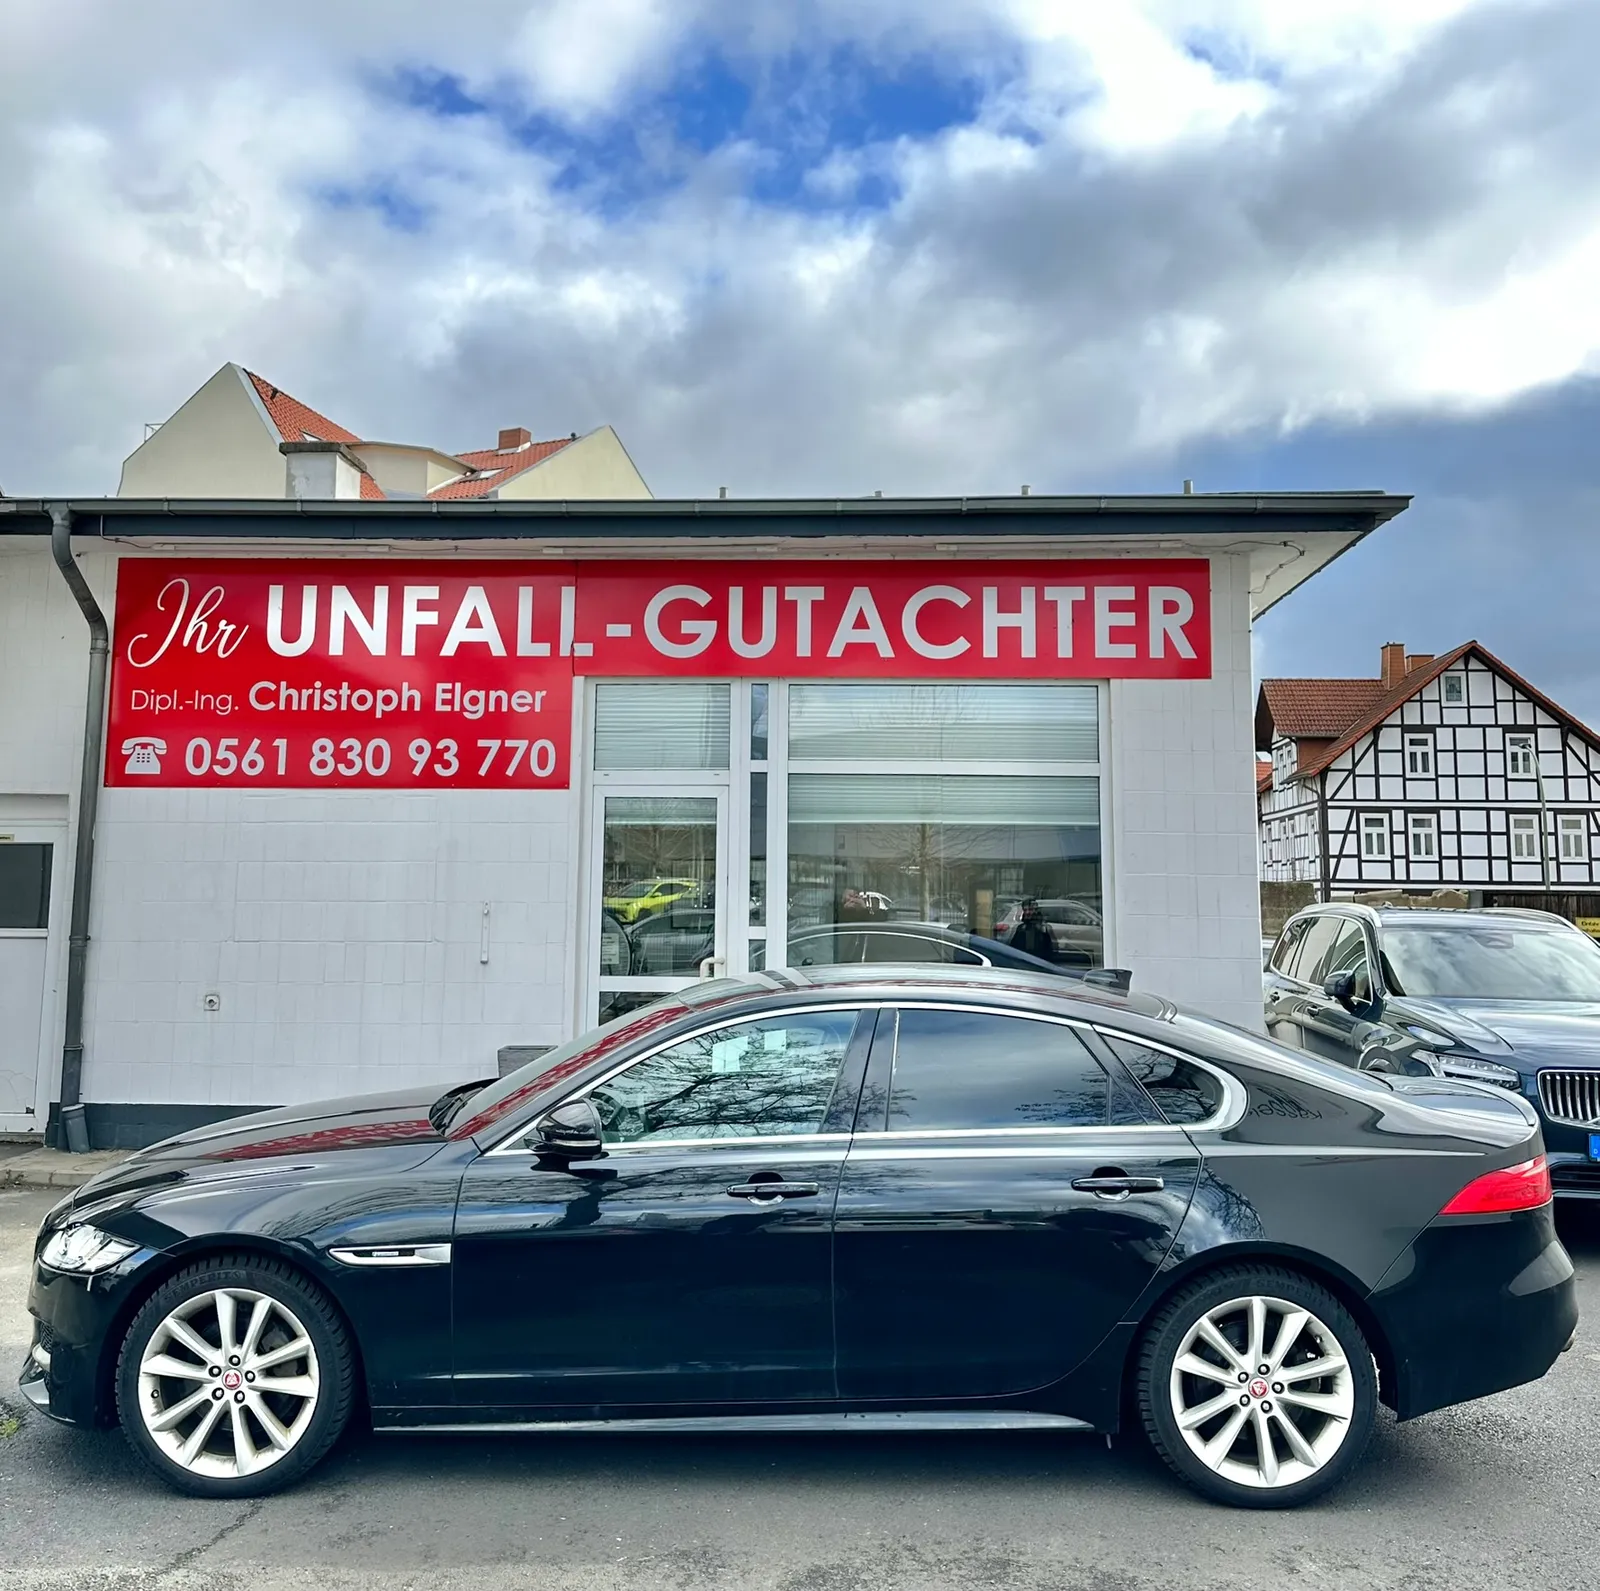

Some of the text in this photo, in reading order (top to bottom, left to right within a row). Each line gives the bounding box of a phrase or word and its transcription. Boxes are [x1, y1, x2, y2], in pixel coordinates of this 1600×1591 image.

[127, 578, 249, 668] Ihr
[131, 680, 548, 720] Dipl.-Ing. Christoph Elgner
[185, 737, 556, 778] 0561 830 93 770
